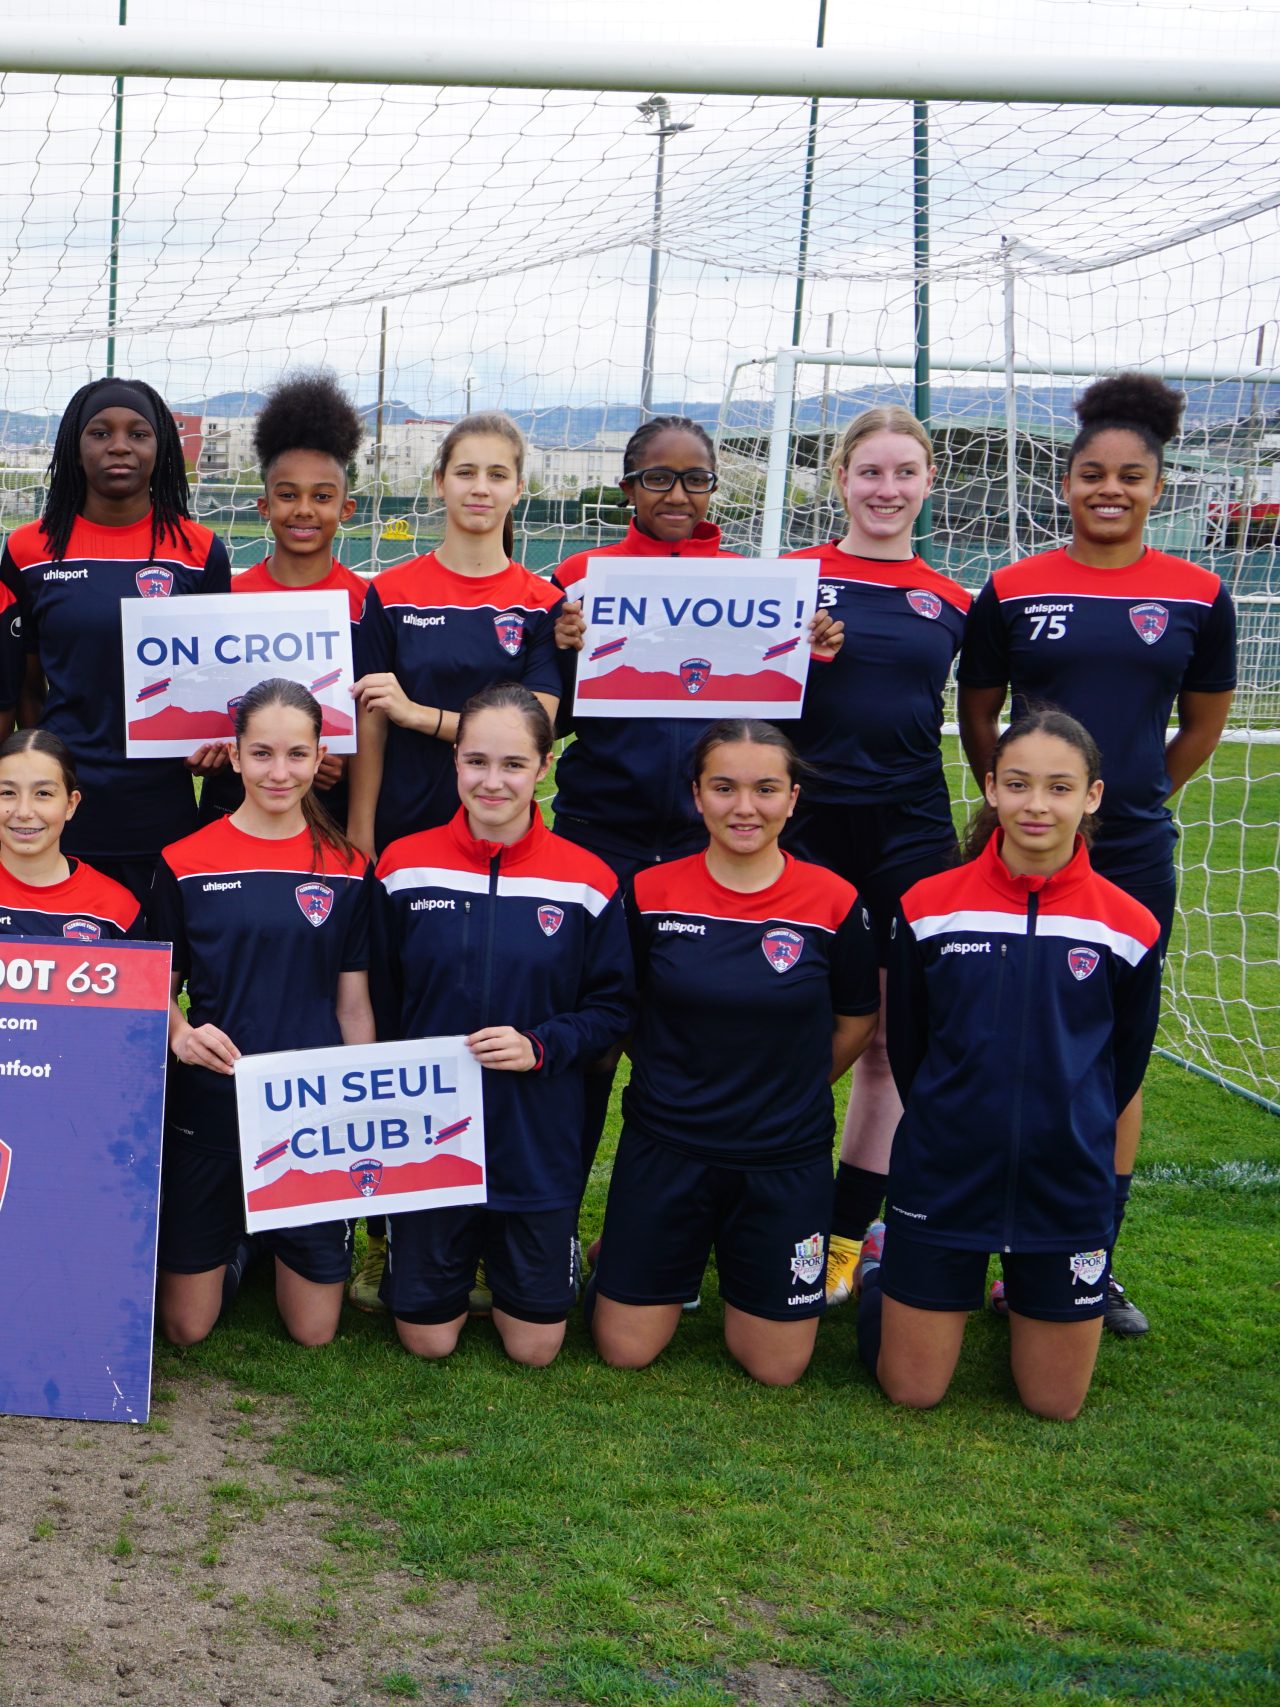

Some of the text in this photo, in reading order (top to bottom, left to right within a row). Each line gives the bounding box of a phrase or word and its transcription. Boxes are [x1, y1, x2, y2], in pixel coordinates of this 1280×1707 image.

[43, 568, 89, 581] uhlsport
[591, 597, 647, 625] EN
[661, 598, 782, 629] VOUS
[1024, 603, 1074, 615] uhlsport
[403, 614, 445, 628] uhlsport
[1029, 615, 1067, 641] 75
[136, 631, 340, 666] ON CROIT
[202, 880, 242, 891] uhlsport
[410, 898, 456, 911] uhlsport
[658, 920, 706, 935] uhlsport
[66, 961, 117, 994] 63
[264, 1064, 457, 1112] UN SEUL
[291, 1118, 410, 1159] CLUB
